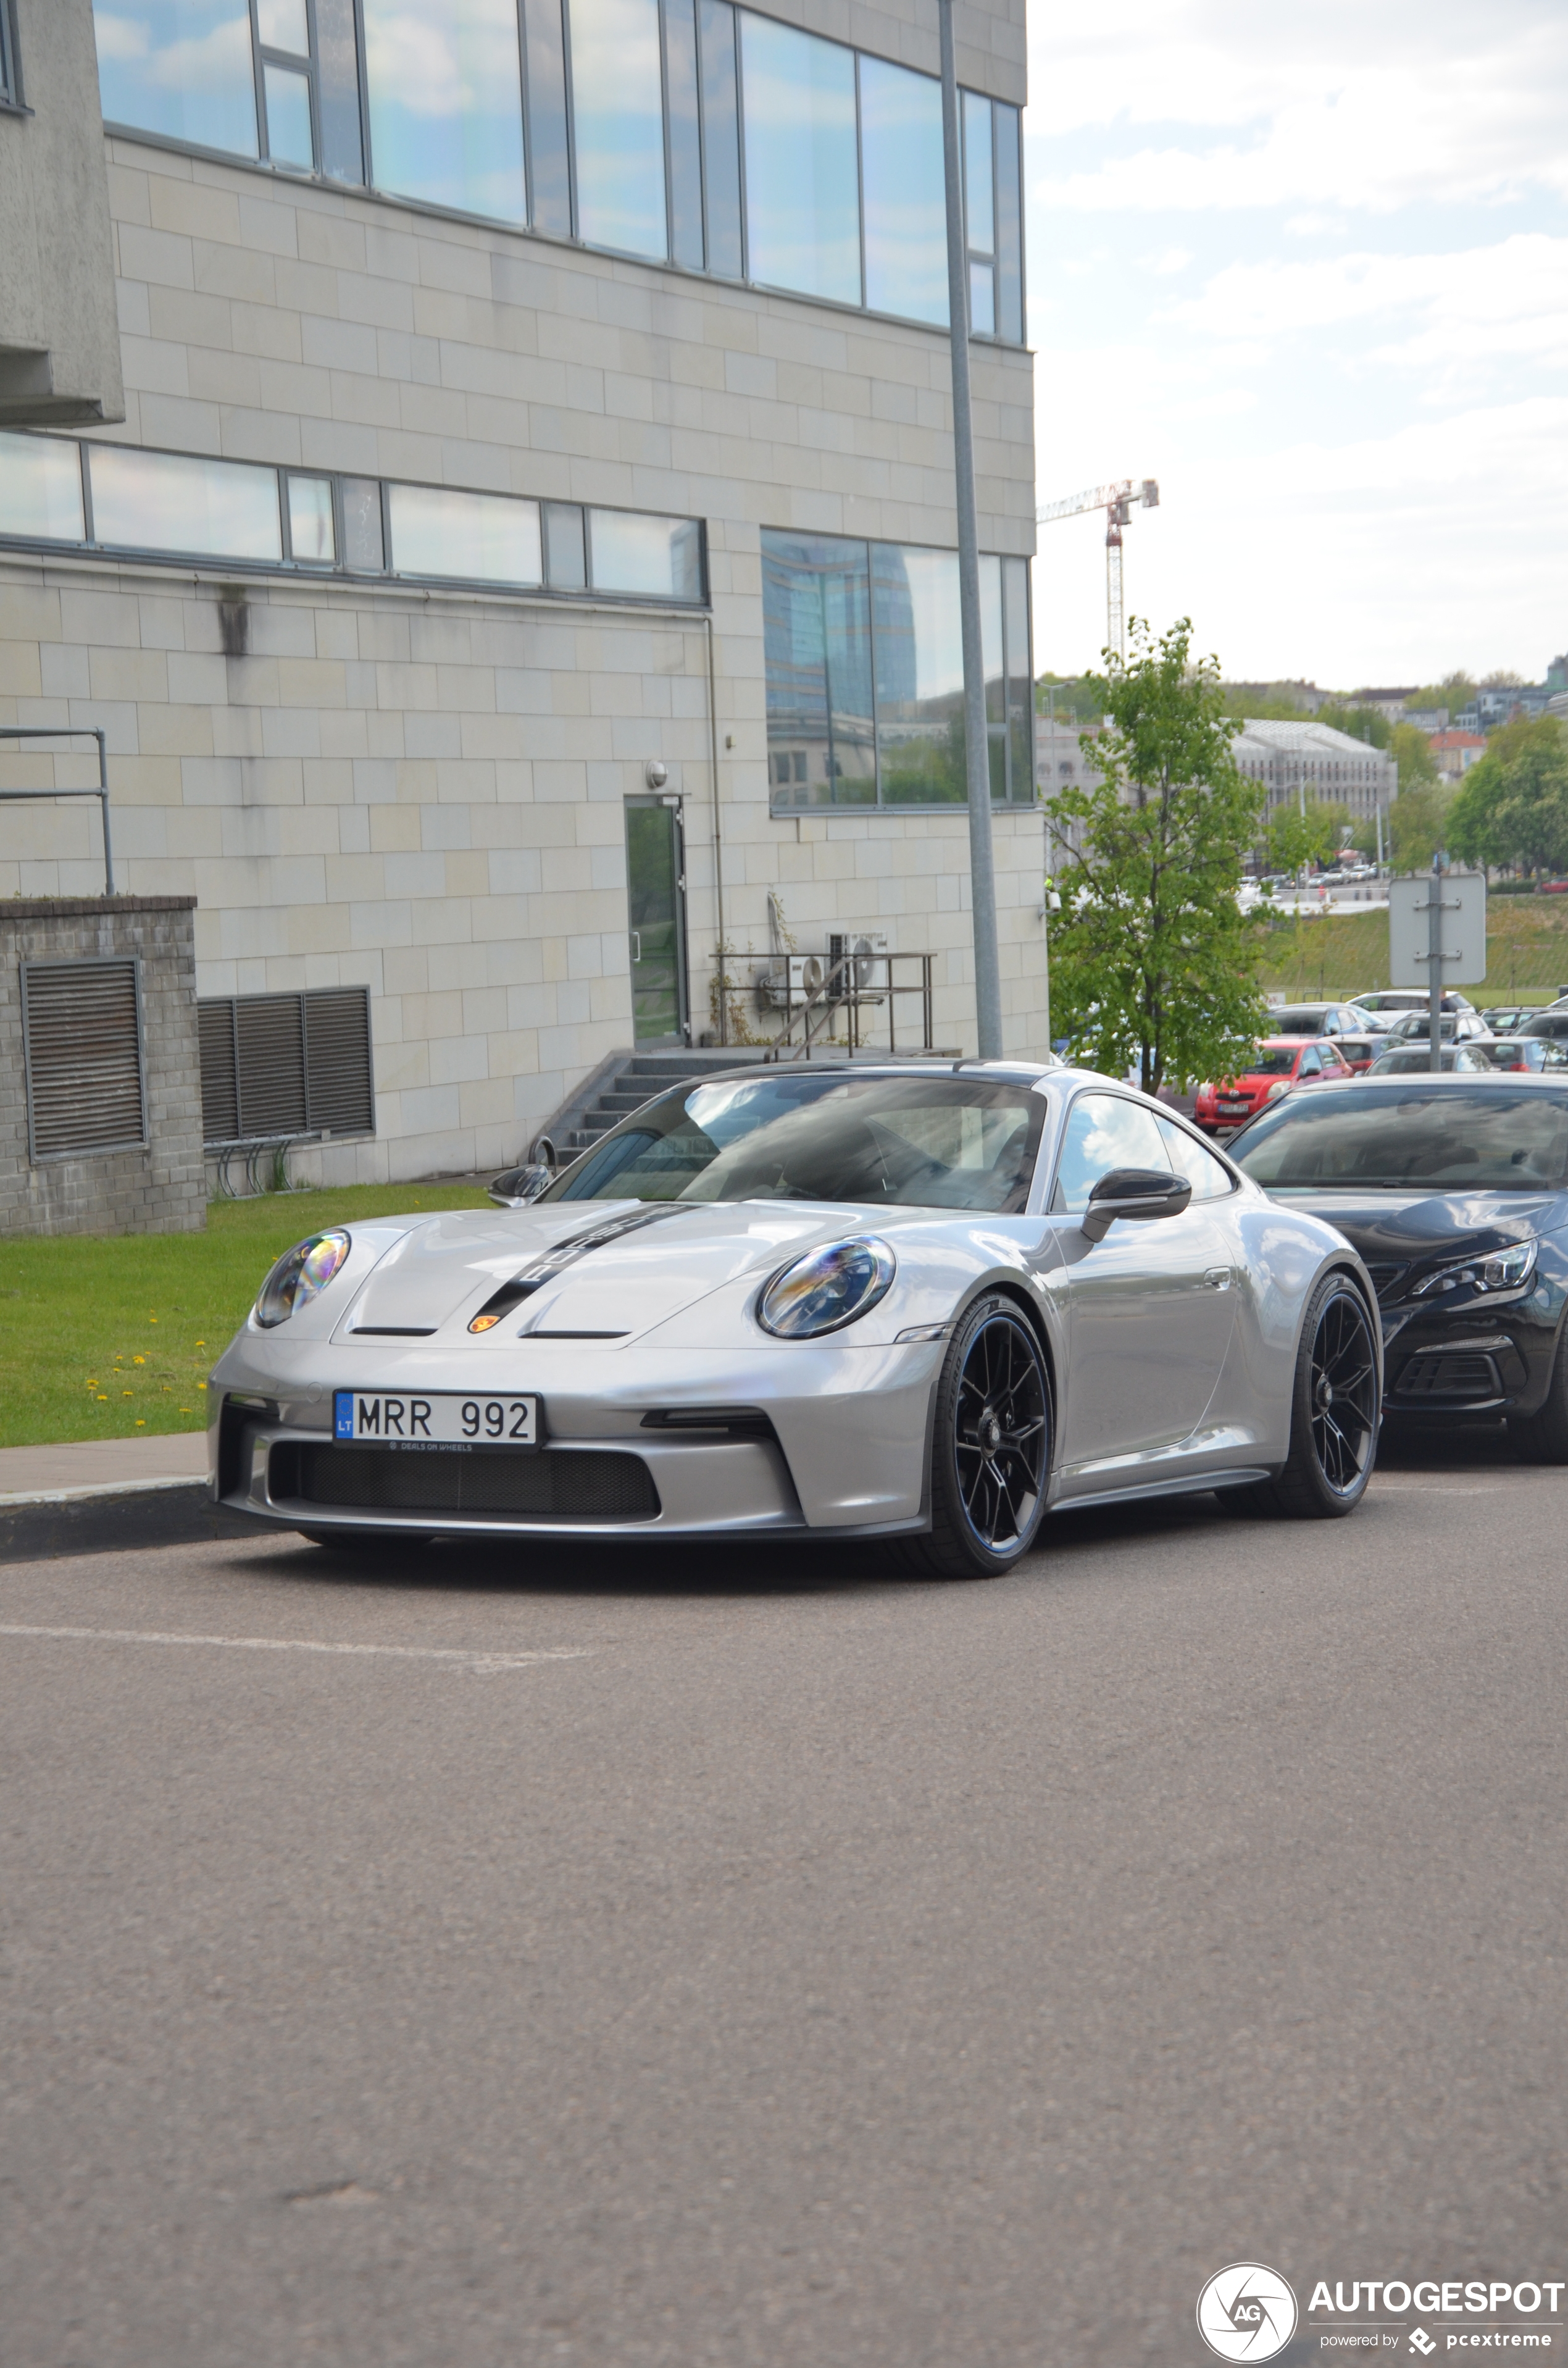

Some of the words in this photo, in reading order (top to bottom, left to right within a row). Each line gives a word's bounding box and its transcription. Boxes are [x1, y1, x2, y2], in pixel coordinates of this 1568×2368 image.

[519, 1205, 686, 1281] PORSCHE
[965, 1322, 977, 1347] CORSA
[338, 1420, 352, 1431] LT
[359, 1398, 432, 1436] MRR
[462, 1400, 528, 1437] 992
